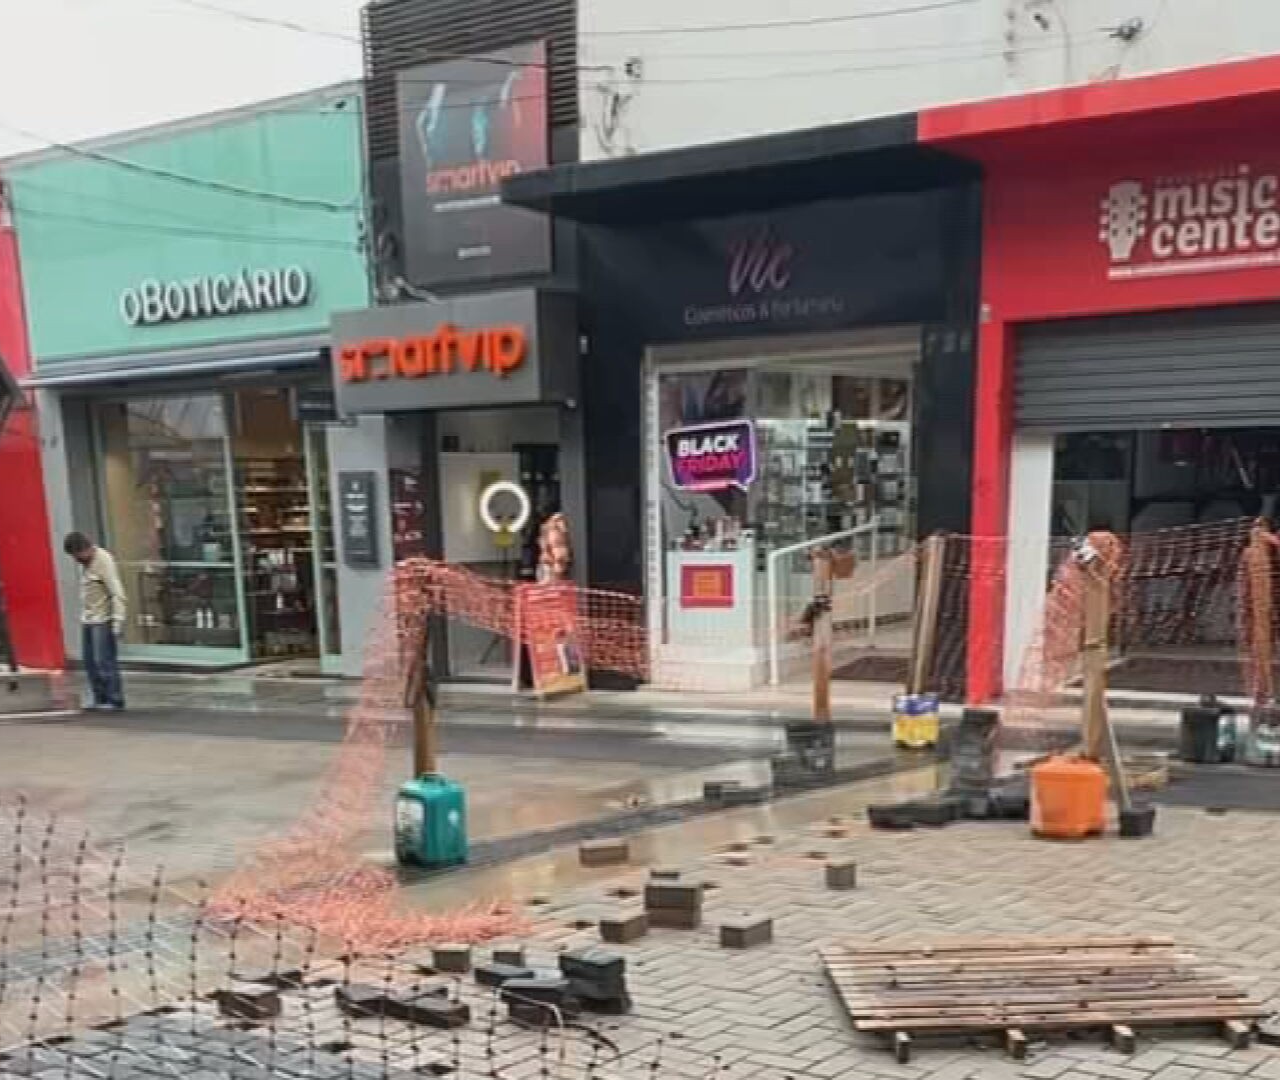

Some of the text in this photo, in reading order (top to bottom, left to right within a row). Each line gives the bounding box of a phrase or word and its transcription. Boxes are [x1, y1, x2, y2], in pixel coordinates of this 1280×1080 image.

[1153, 164, 1279, 222] music
[677, 432, 740, 457] BLACK
[676, 450, 746, 473] FRIDAY
